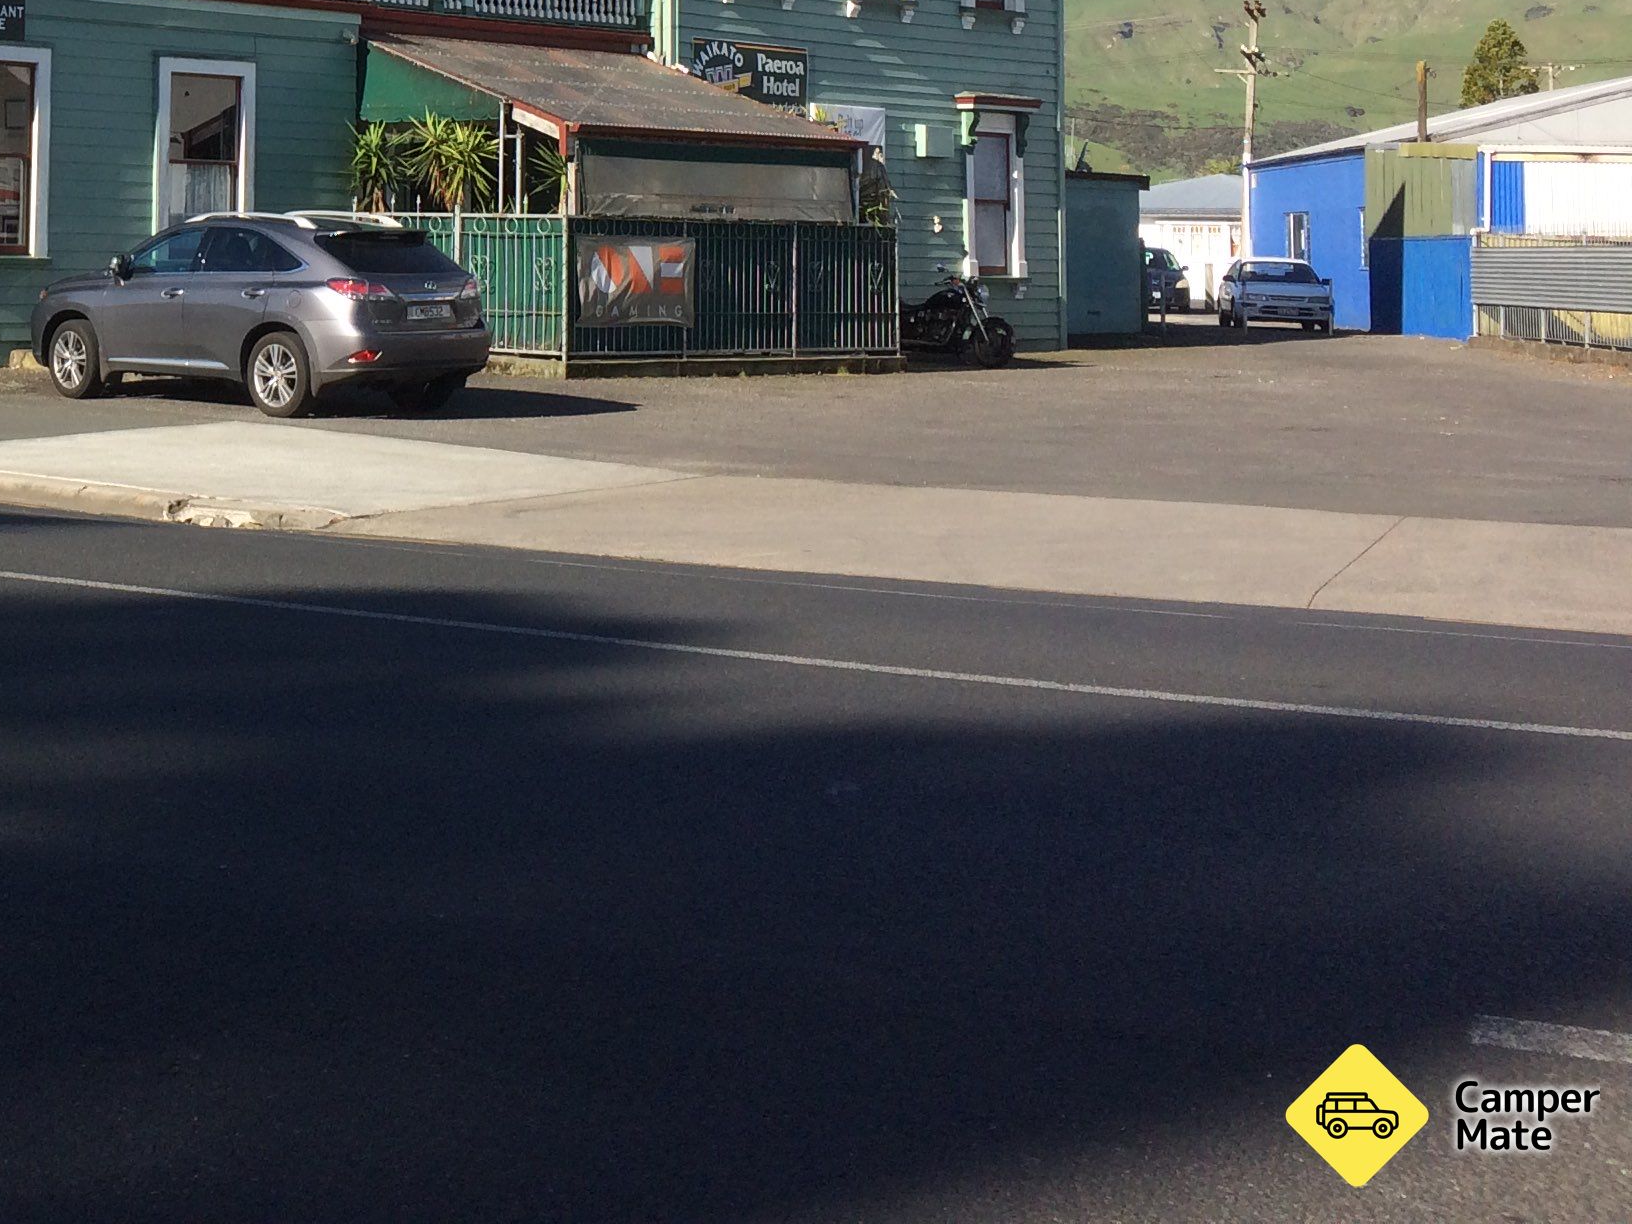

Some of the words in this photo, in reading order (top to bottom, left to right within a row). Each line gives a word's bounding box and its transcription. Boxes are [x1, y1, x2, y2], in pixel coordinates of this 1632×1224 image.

[692, 40, 744, 76] WAIKATO
[757, 52, 805, 76] Paeroa
[762, 76, 800, 97] Hotel
[595, 303, 683, 317] GAMING
